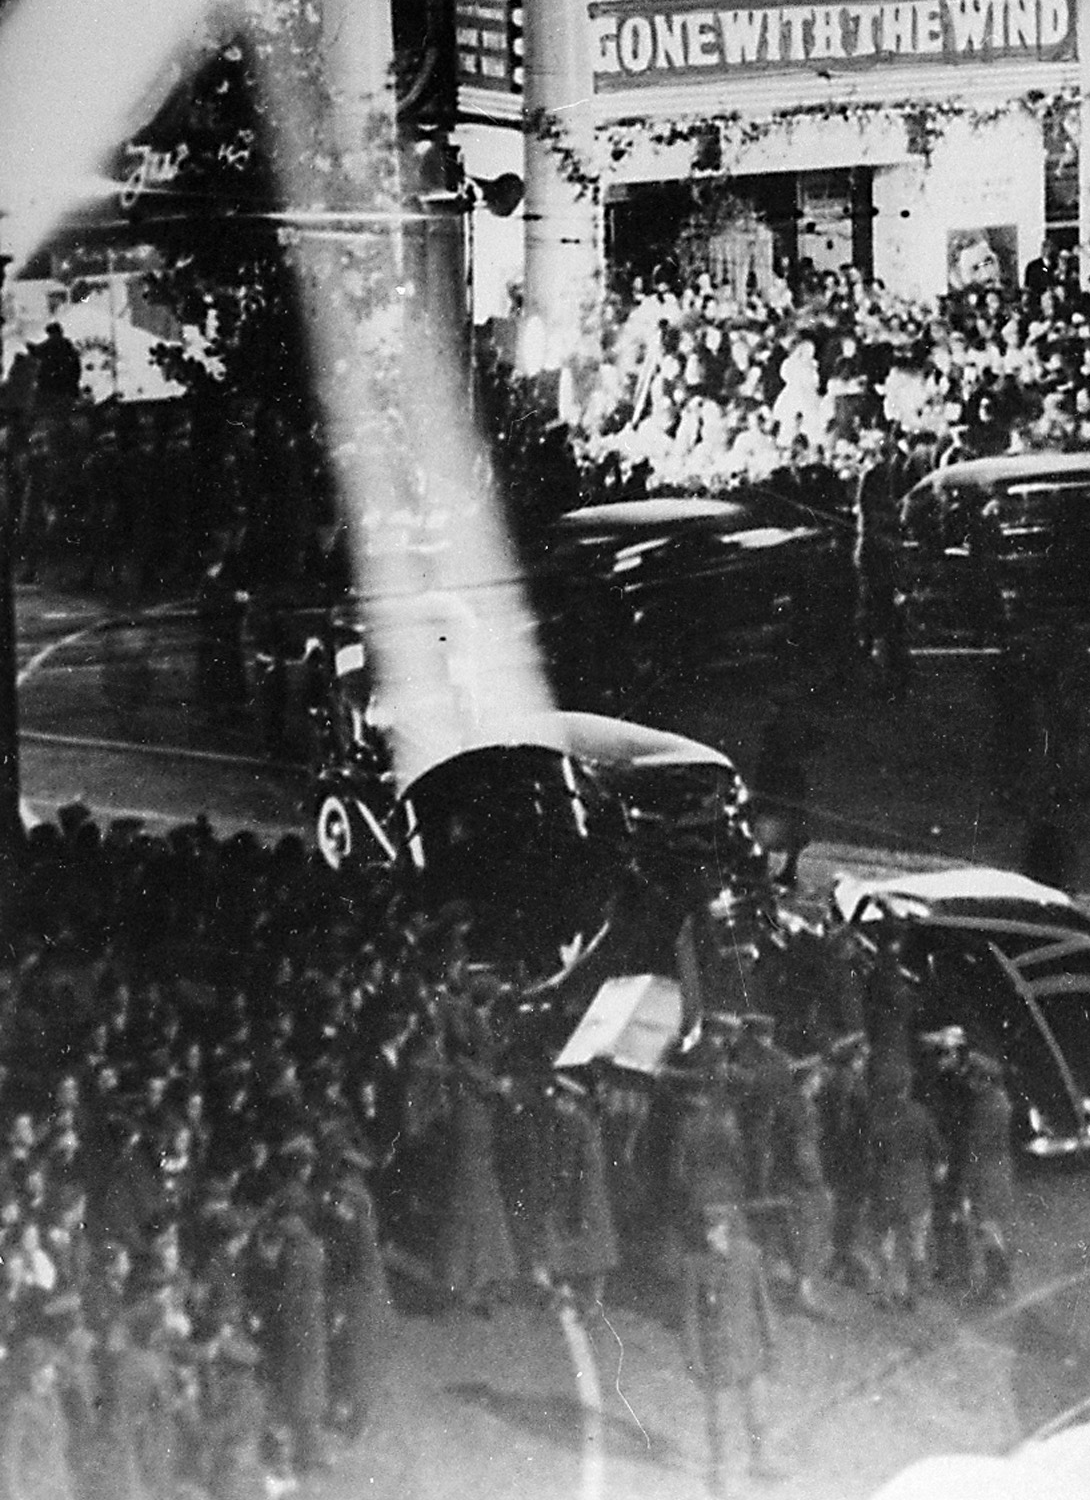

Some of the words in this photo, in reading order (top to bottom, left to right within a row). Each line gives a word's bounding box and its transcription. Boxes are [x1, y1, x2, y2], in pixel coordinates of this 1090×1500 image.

[593, 12, 720, 73] GONE
[716, 4, 842, 63] WITH
[844, 0, 943, 57] THE
